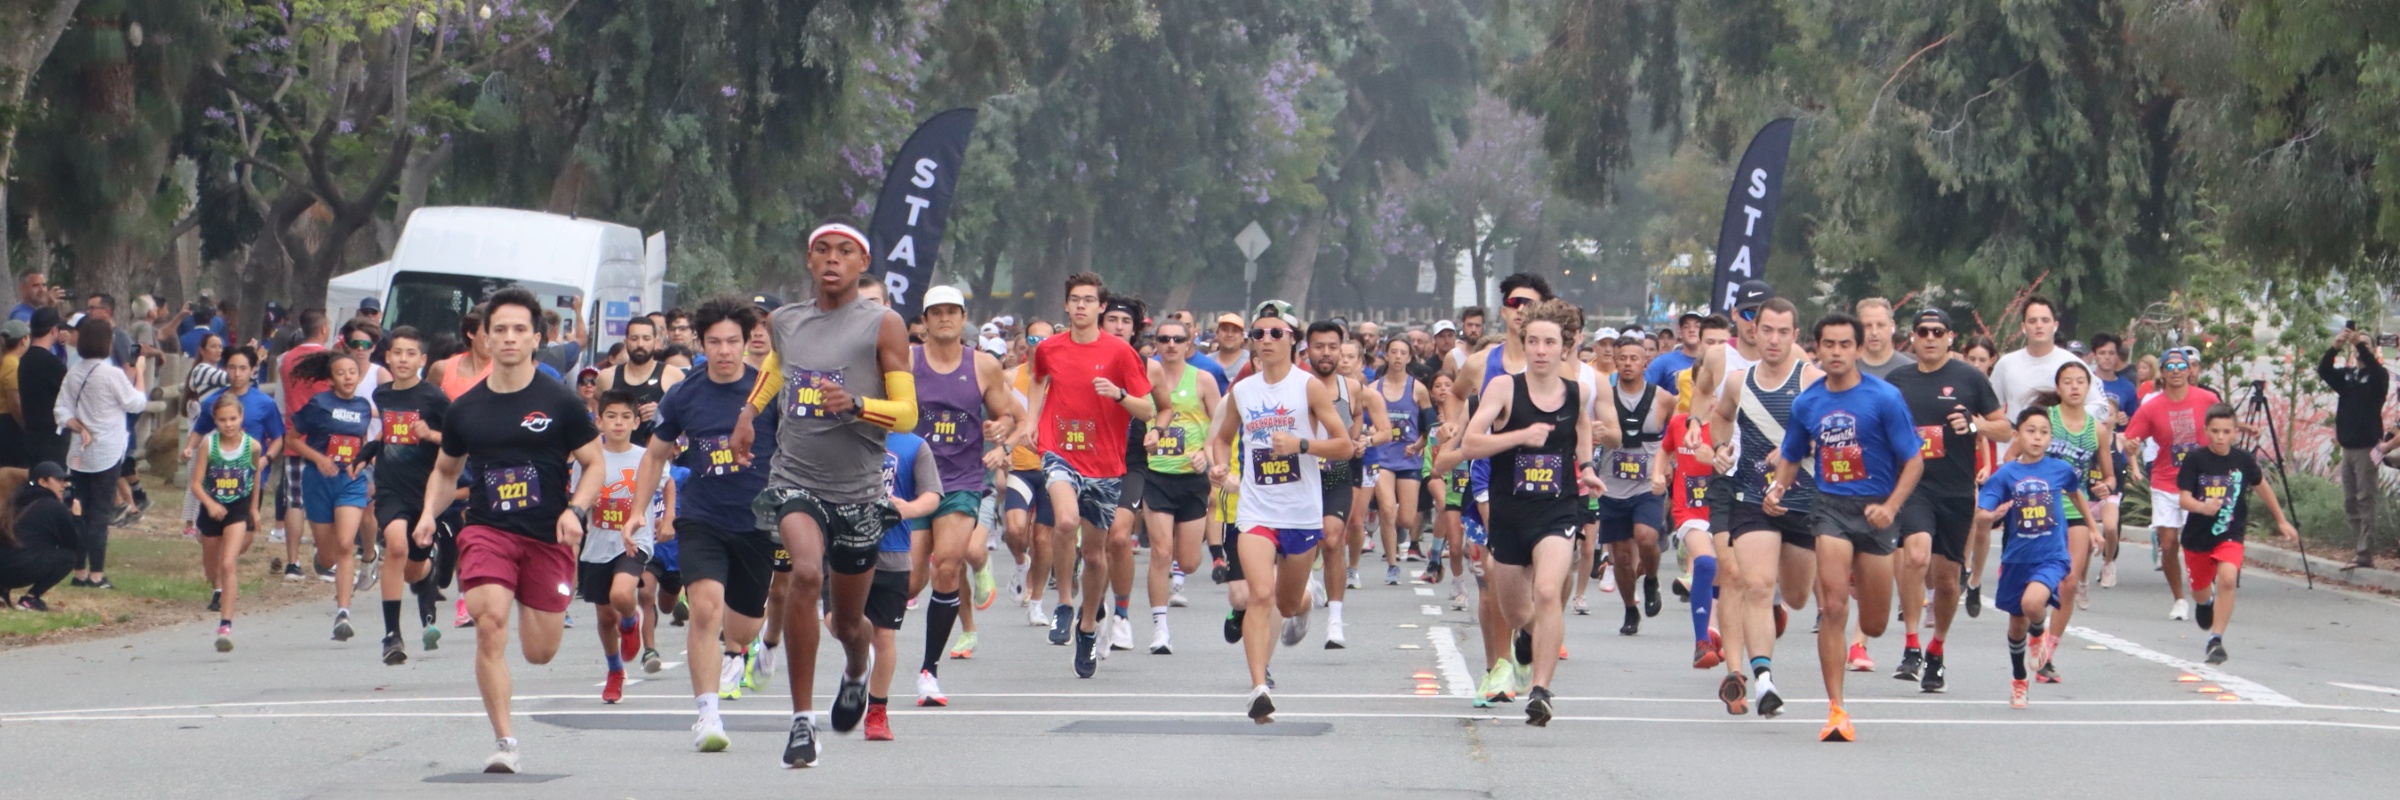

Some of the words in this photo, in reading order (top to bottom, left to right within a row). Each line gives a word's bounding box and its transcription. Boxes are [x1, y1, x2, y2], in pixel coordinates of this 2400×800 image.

[884, 157, 938, 305] STAR
[1723, 168, 1768, 311] STAR
[393, 424, 408, 435] 103
[934, 421, 955, 434] 1111
[1066, 431, 1084, 442] 316
[1158, 437, 1177, 448] 503
[710, 449, 733, 465] 130
[1261, 461, 1290, 475] 1025
[1620, 462, 1639, 472] 1153
[1831, 461, 1851, 473] 152
[1524, 469, 1553, 482] 1022
[497, 482, 527, 499] 1227
[603, 510, 623, 522] 331
[2022, 506, 2046, 519] 1210
